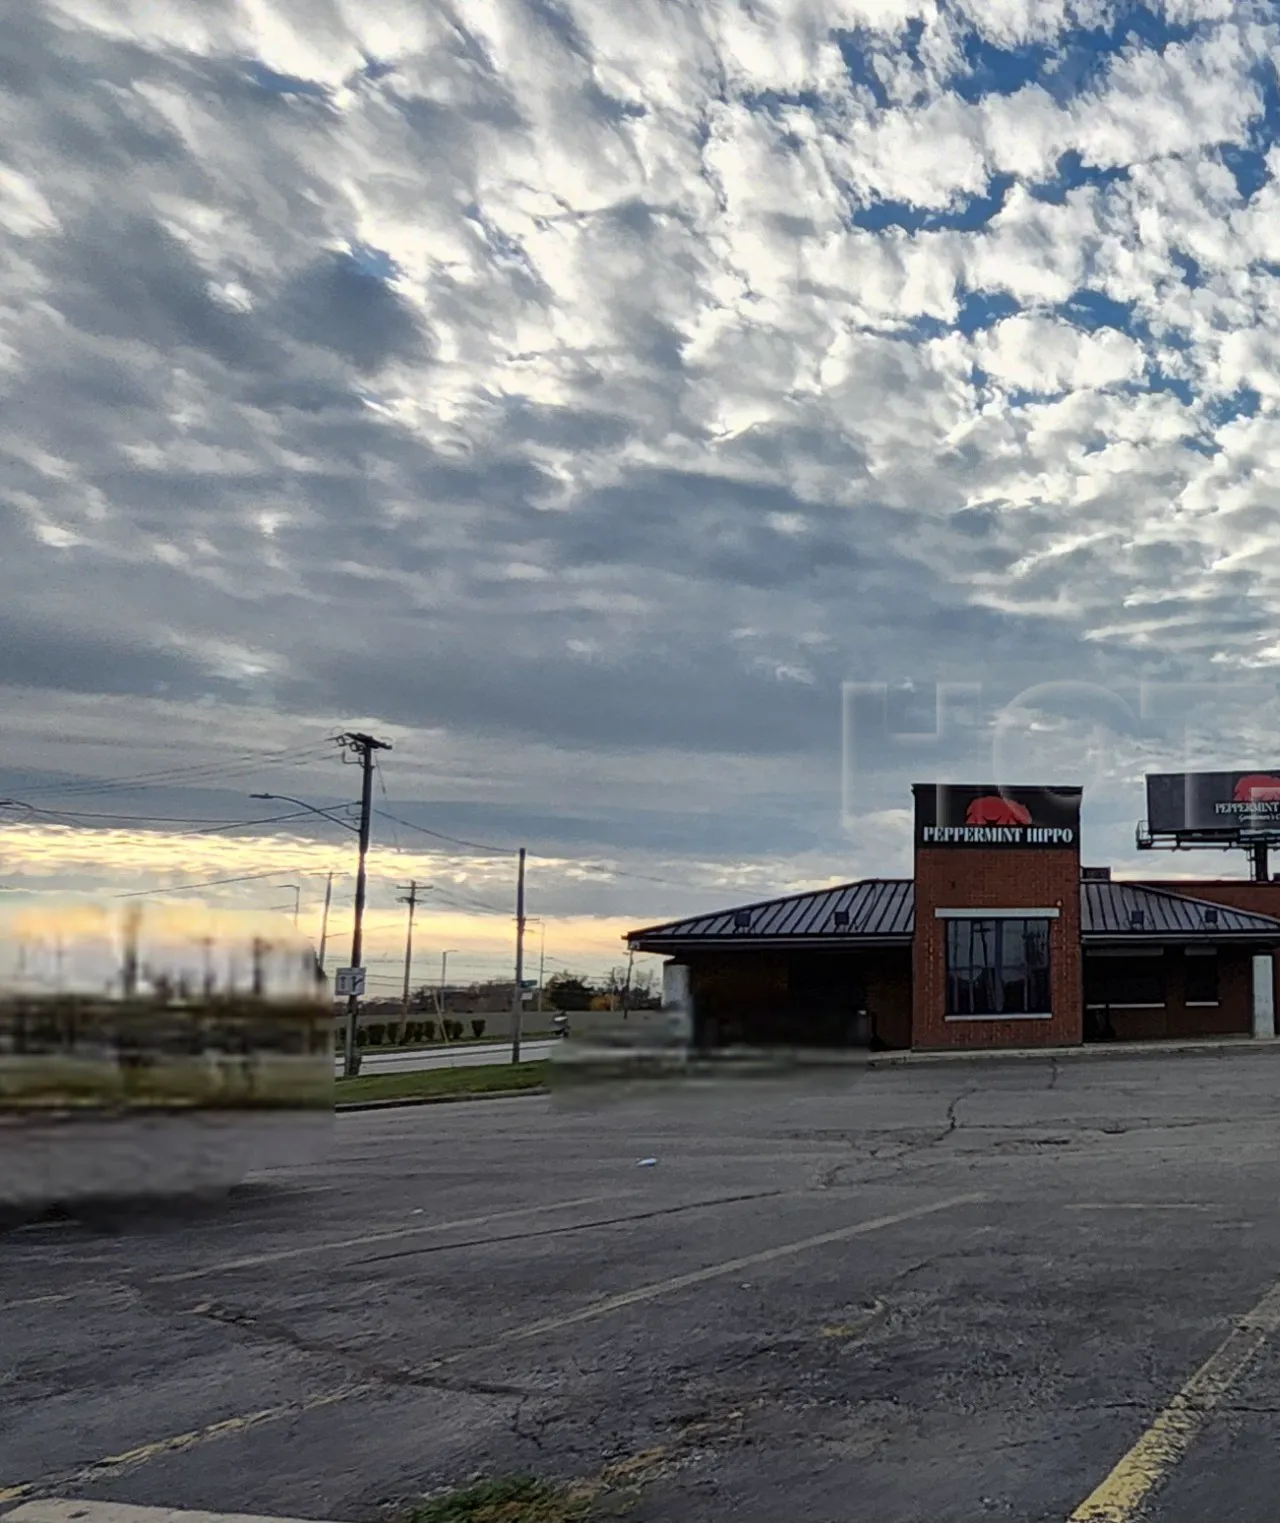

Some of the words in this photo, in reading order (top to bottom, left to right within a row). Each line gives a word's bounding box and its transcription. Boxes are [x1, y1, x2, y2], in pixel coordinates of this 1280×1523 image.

[1215, 802, 1280, 814] PEPPERMINT
[923, 827, 1022, 843] PEPPERMINT
[1026, 827, 1073, 843] HIPPO
